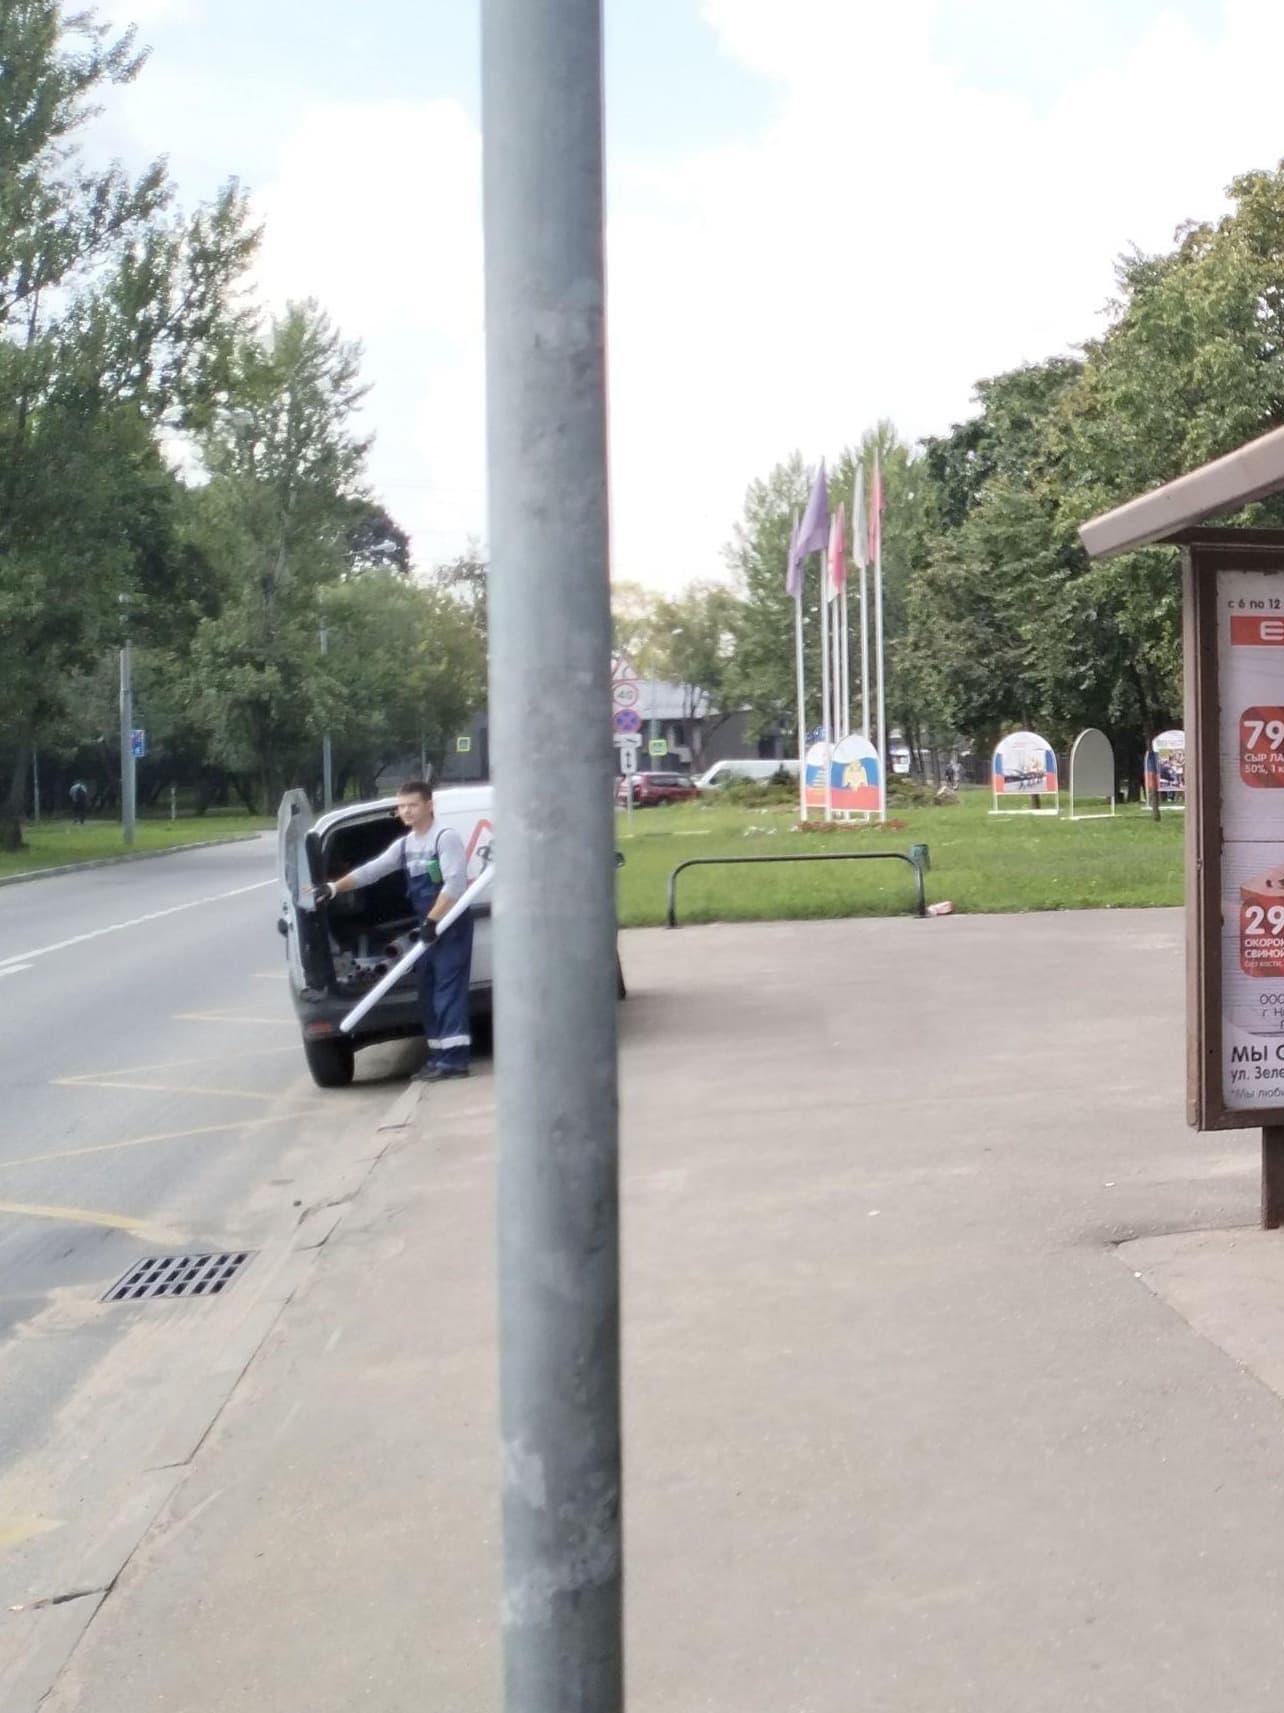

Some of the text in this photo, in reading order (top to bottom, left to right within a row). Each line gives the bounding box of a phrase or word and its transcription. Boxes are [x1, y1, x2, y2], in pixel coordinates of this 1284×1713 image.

[1228, 601, 1235, 609] с
[1238, 598, 1245, 609] 6
[1250, 601, 1265, 609] по
[1268, 598, 1281, 609] 12
[1244, 752, 1267, 762] СЫР
[1244, 764, 1268, 775] 50%,
[1231, 1044, 1268, 1064] МЫ
[1230, 1068, 1250, 1084] ул.
